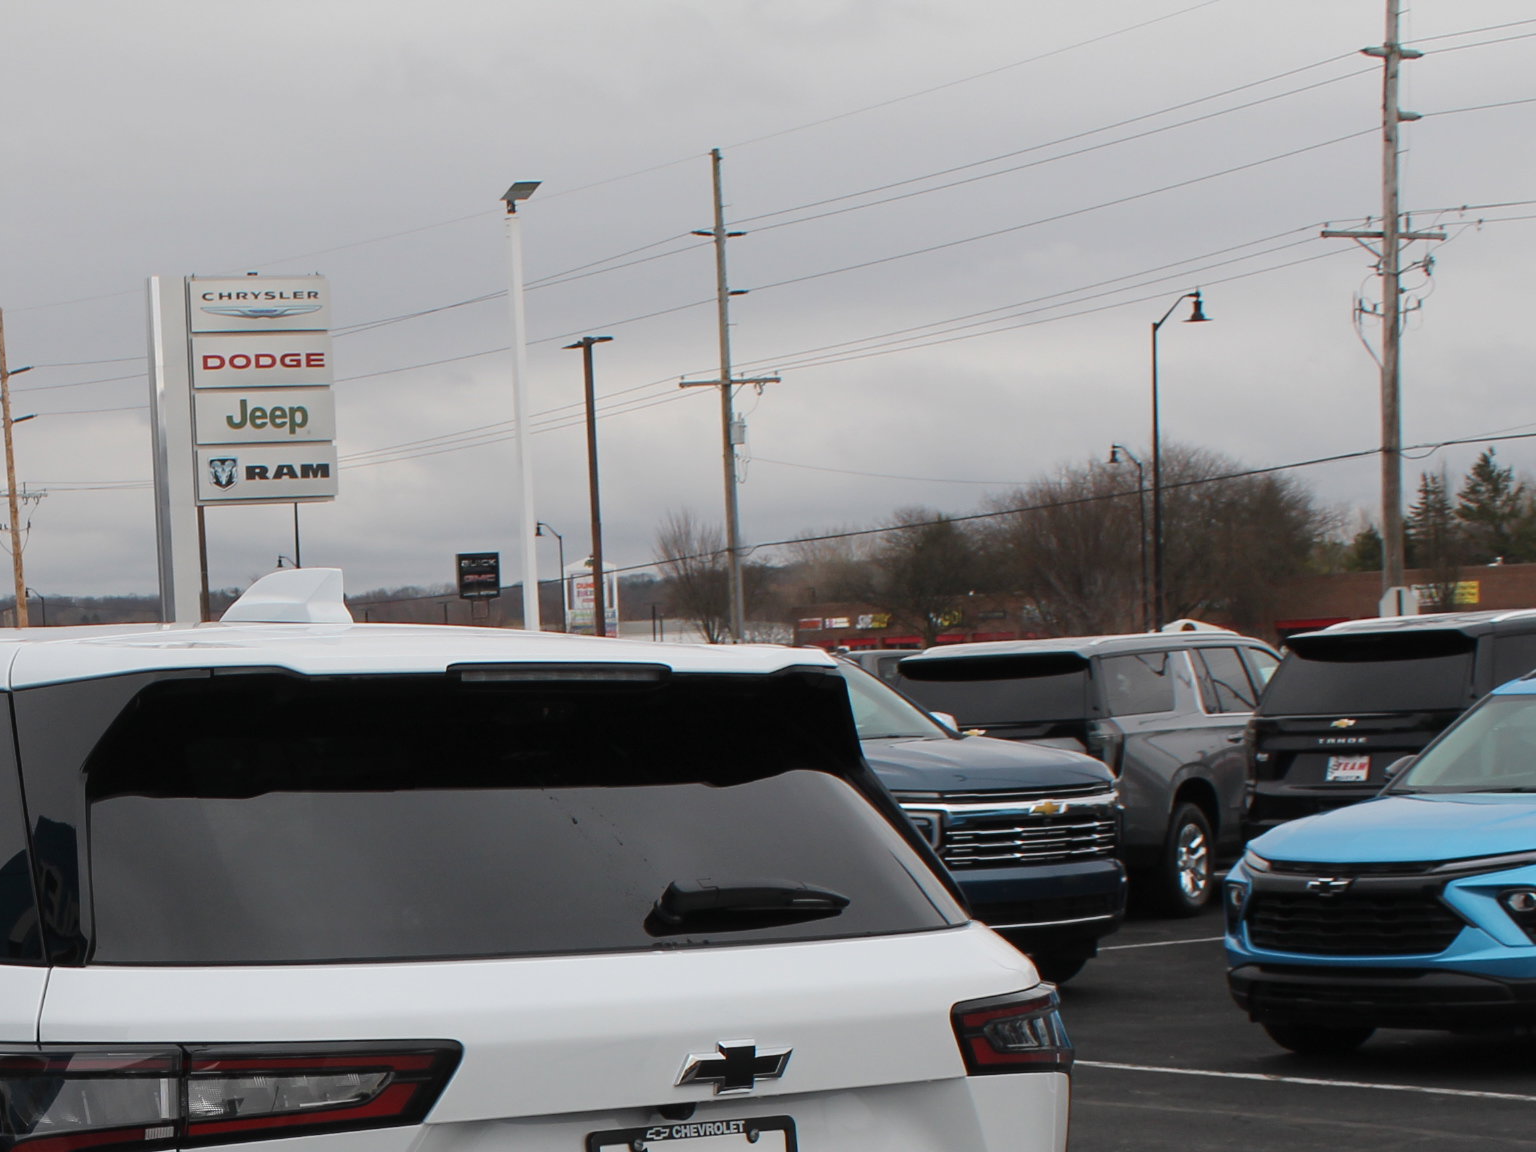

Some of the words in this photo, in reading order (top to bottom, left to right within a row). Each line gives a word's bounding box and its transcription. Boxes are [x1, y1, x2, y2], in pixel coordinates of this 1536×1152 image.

[201, 290, 320, 301] CHRYSLER
[201, 352, 326, 370] DODGE
[225, 398, 309, 435] Jeep
[244, 463, 331, 481] RAM
[1318, 736, 1368, 744] TAHOE
[672, 1120, 746, 1139] CHEVROLET
